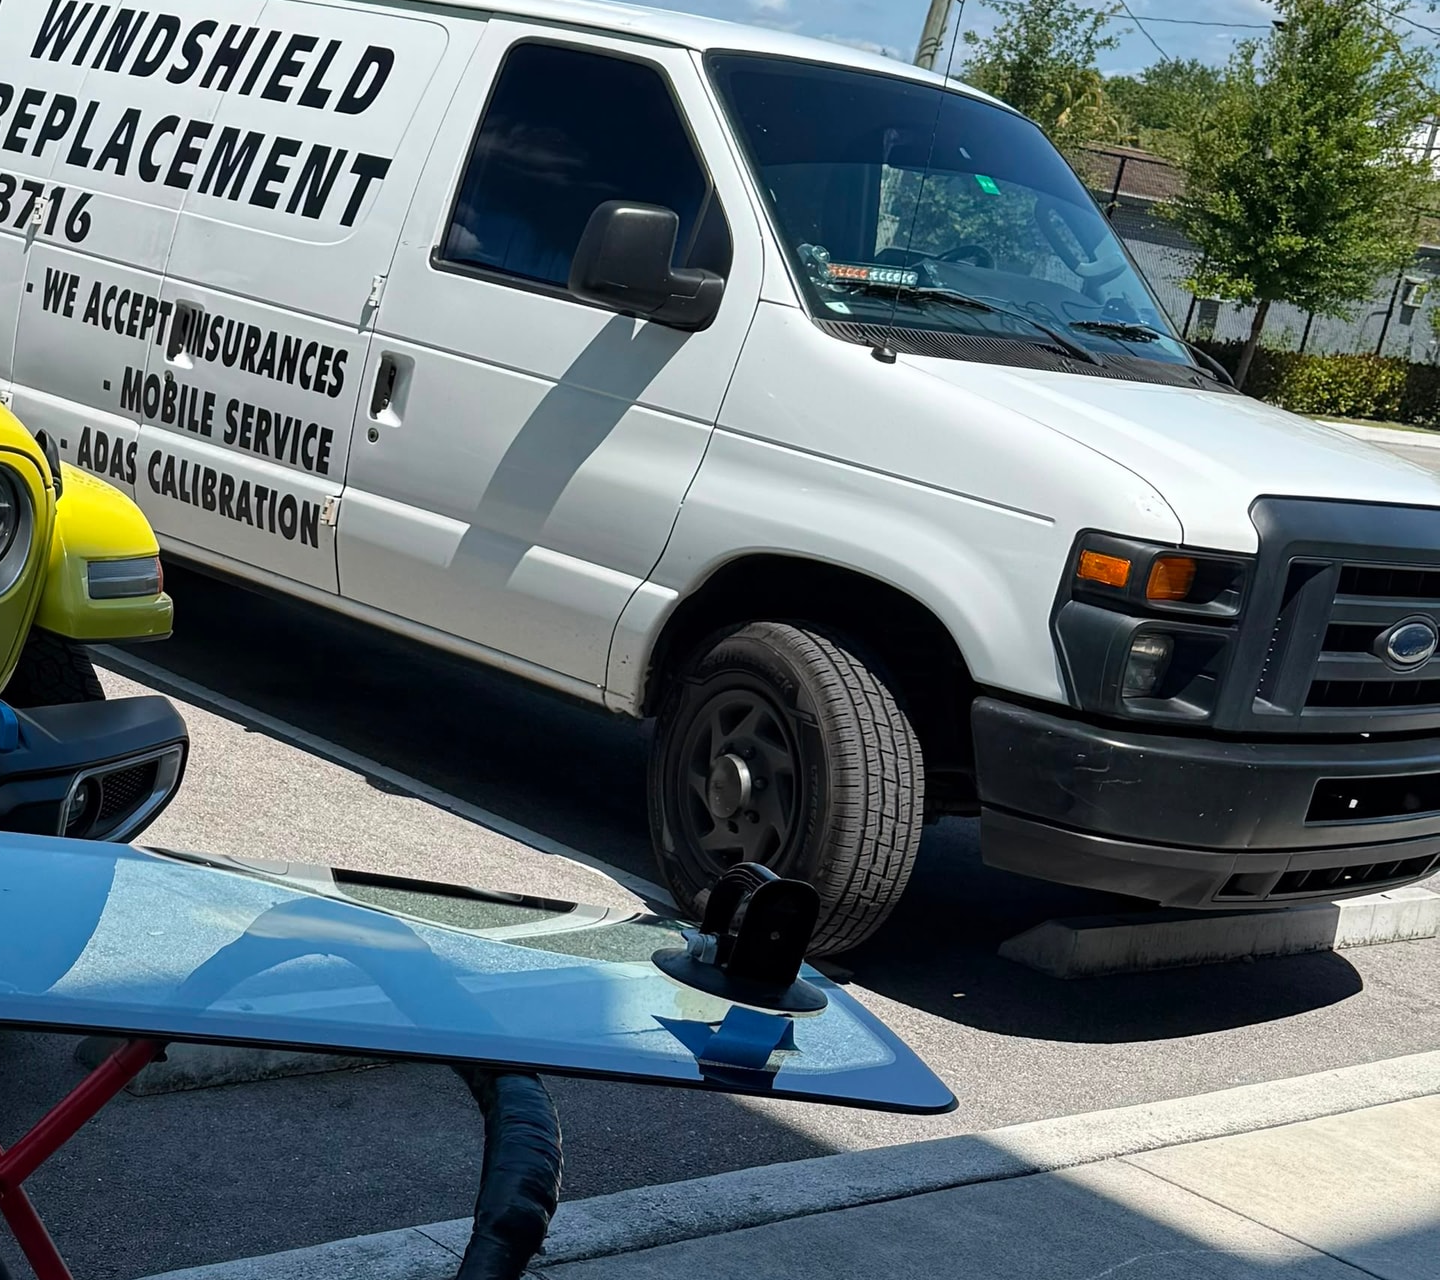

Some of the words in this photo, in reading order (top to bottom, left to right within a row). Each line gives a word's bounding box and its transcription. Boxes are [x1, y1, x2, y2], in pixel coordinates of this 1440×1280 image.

[42, 267, 81, 318] WE
[82, 281, 174, 346] ACCEPT
[186, 308, 349, 399] INSURANCES
[119, 366, 217, 438] MOBILE
[223, 398, 335, 476] SERVICE
[77, 426, 139, 485] ADAS
[147, 449, 321, 549] CALIBRATION
